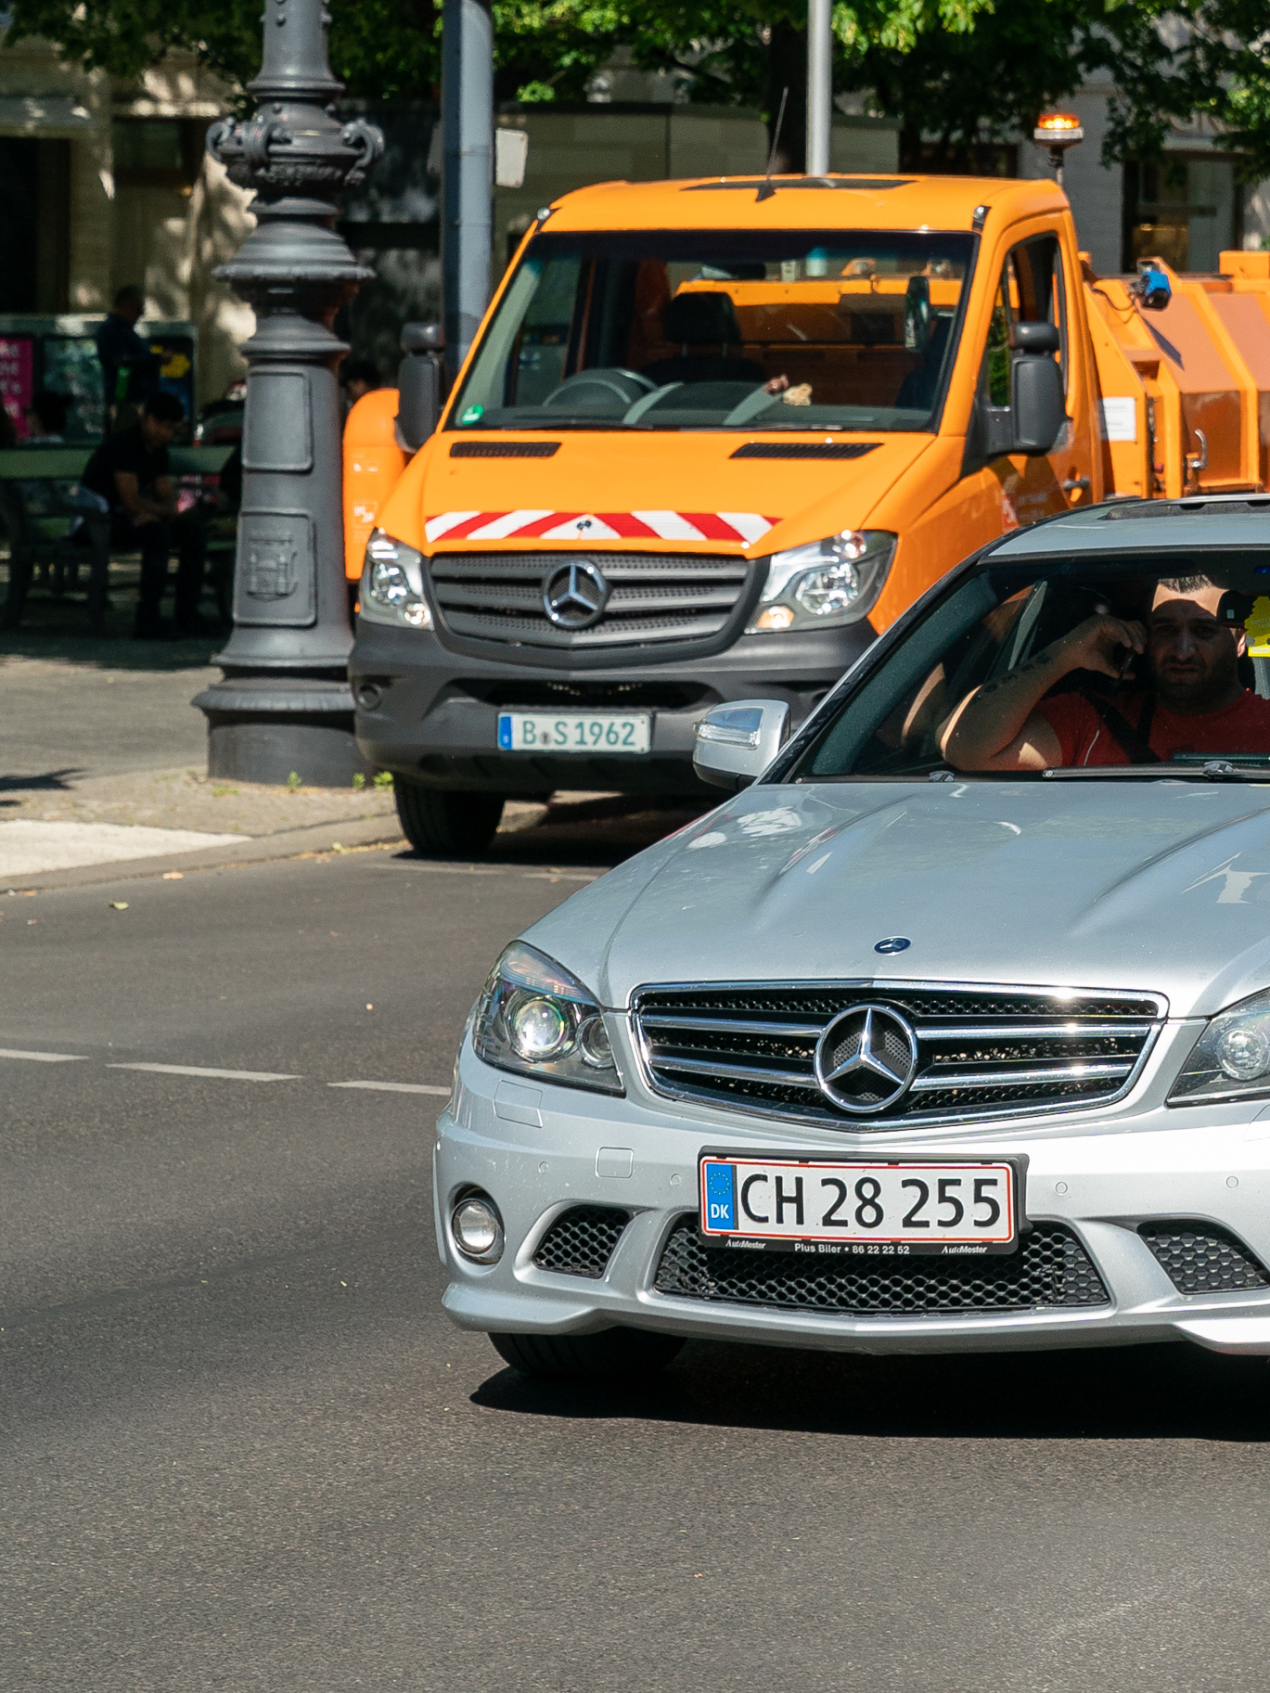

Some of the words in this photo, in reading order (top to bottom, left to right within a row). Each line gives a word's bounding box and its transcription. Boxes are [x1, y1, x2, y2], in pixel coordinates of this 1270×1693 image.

[522, 720, 537, 745] B
[740, 1173, 804, 1225] CH
[820, 1176, 884, 1228] 28
[901, 1178, 1001, 1228] 255
[710, 1203, 730, 1219] DK
[794, 1243, 816, 1253] Plus
[818, 1243, 842, 1254] Biler
[852, 1245, 865, 1254] 86
[867, 1245, 880, 1254] 22
[882, 1246, 895, 1255] 22
[897, 1246, 910, 1255] 52
